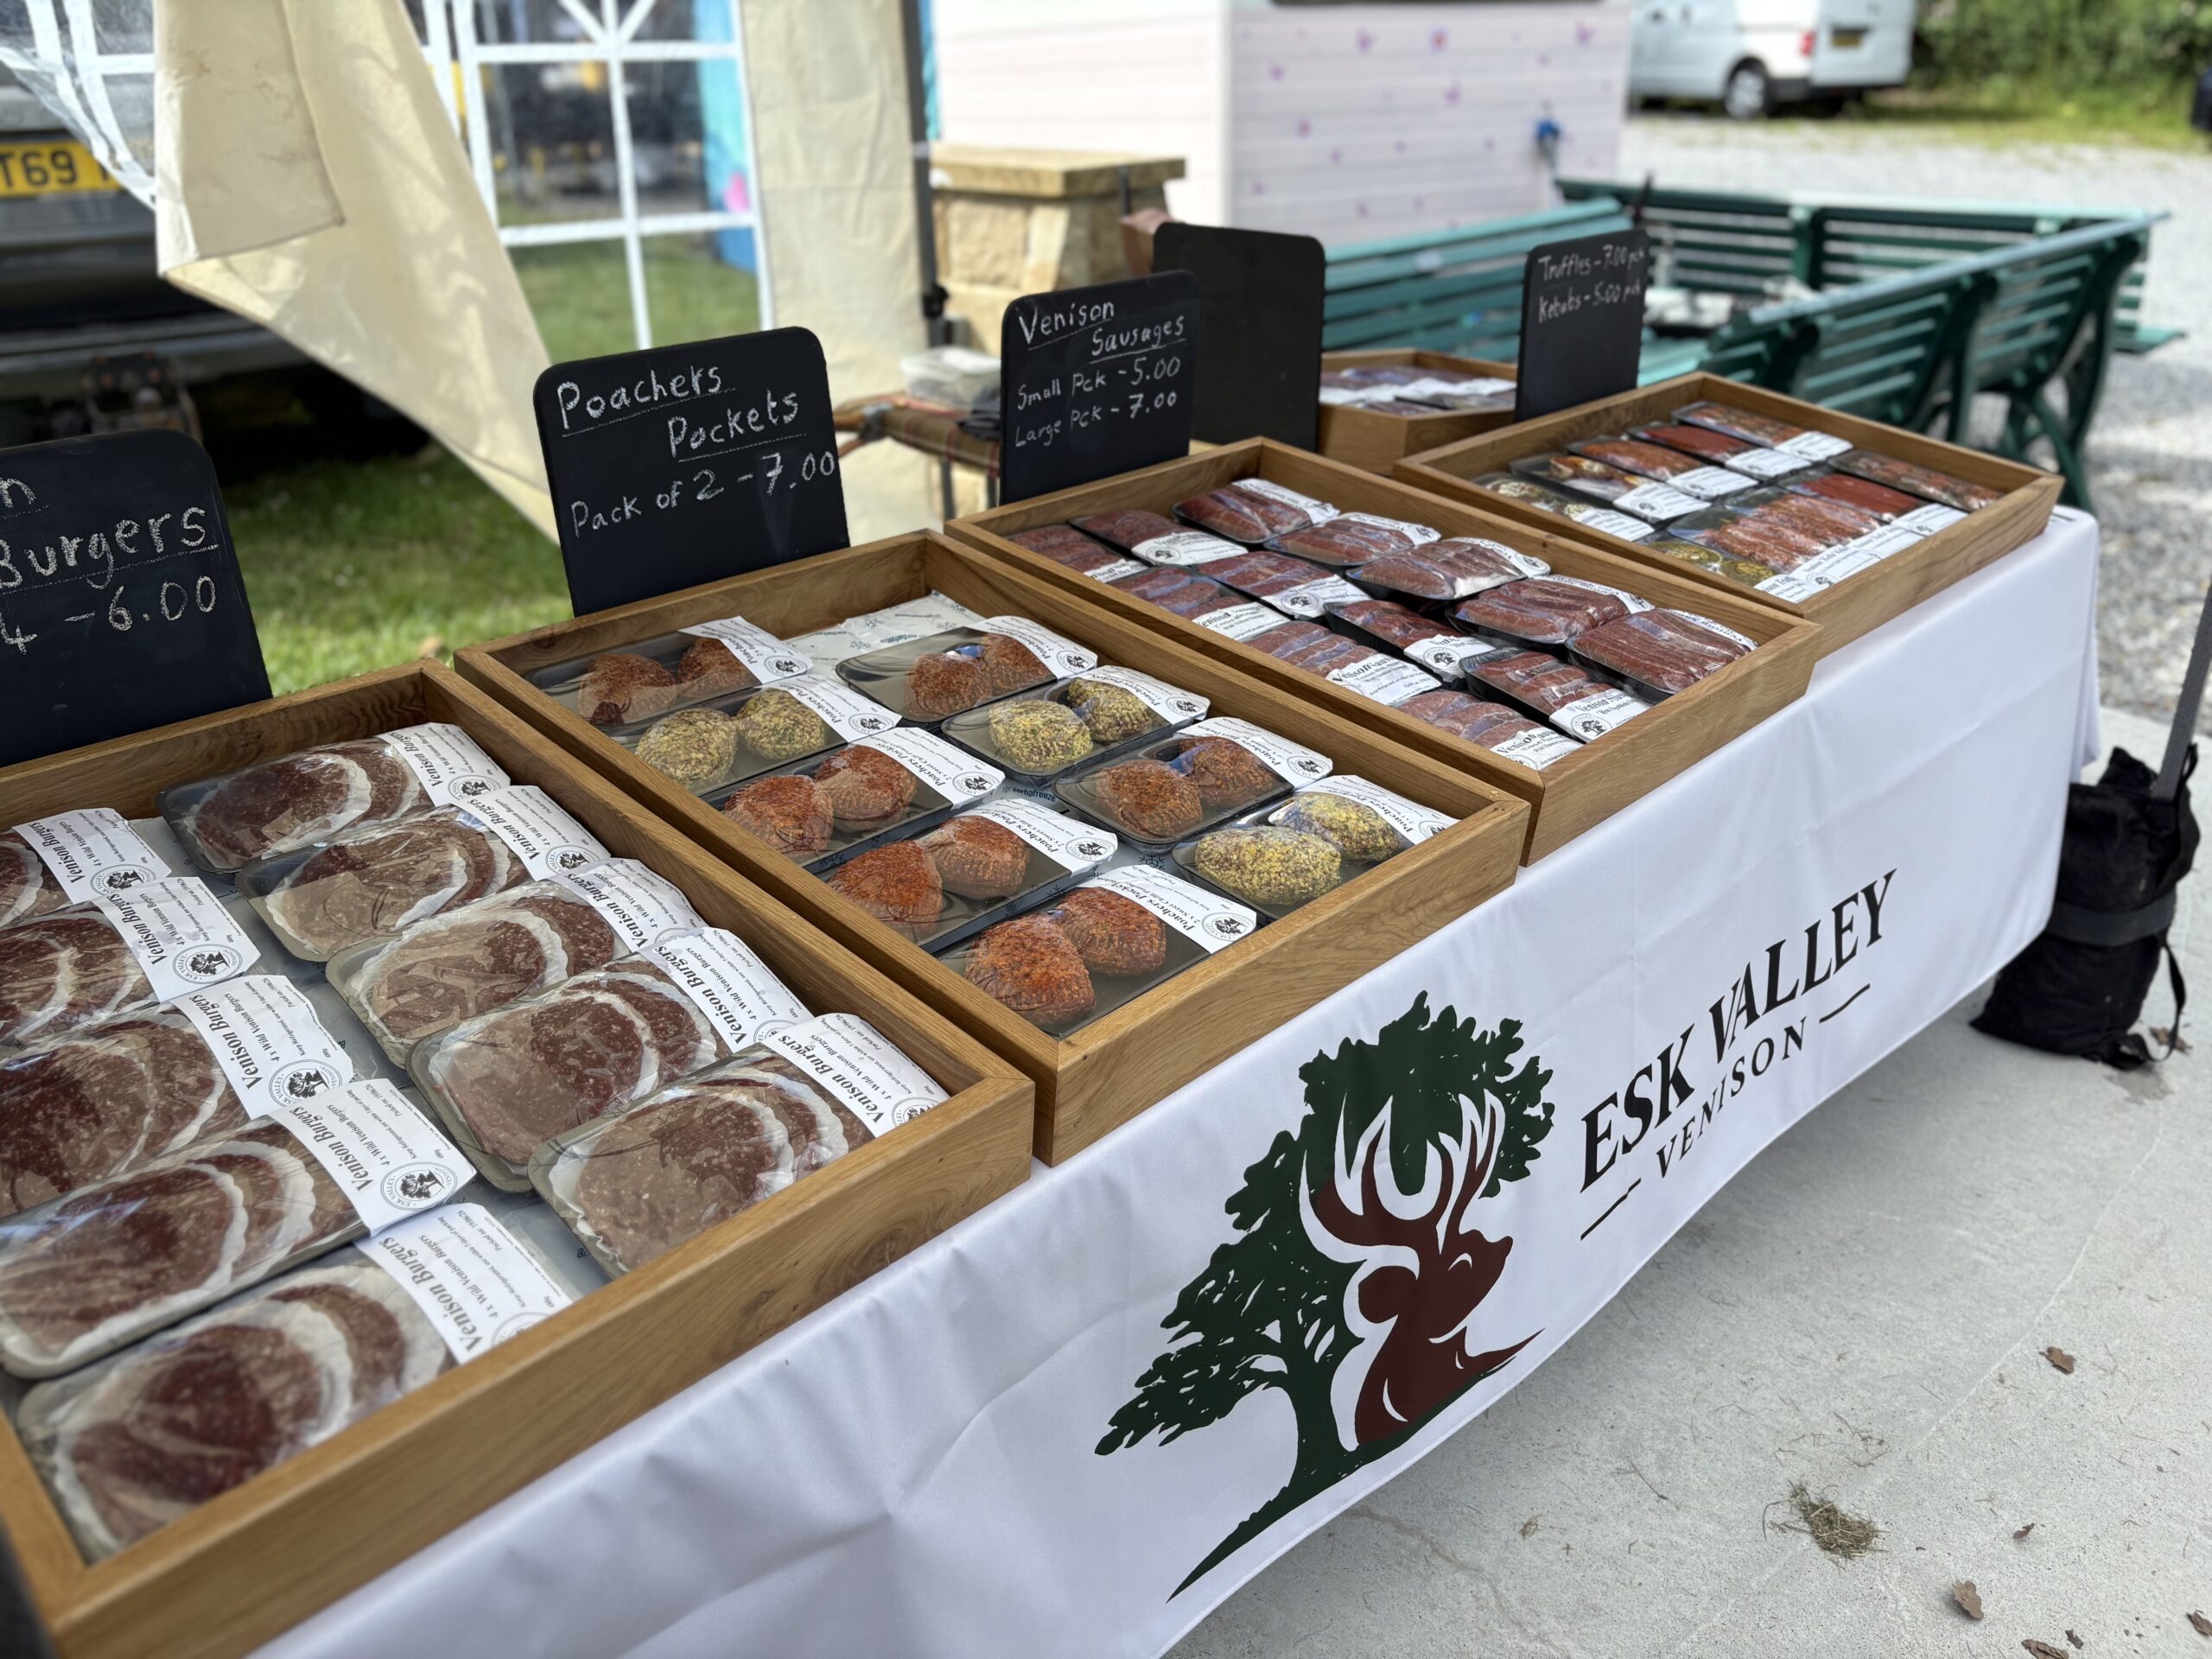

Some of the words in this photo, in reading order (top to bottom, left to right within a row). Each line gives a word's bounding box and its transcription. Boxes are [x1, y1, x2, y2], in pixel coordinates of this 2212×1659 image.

[1538, 254, 1591, 282] Truffles
[1019, 302, 1115, 344] Venison
[1091, 315, 1185, 355] Sausages
[557, 365, 721, 429] Poachers
[1018, 378, 1062, 410] Small
[668, 390, 798, 457] Pockets
[1015, 420, 1061, 447] Large
[571, 497, 642, 537] Pack
[657, 480, 683, 509] of
[694, 470, 724, 500] 2
[1198, 612, 1232, 627] enison
[728, 636, 759, 664] Poachers
[808, 696, 845, 724] Poachers
[1122, 682, 1161, 706] Poachers
[1574, 698, 1609, 712] Venison
[386, 729, 419, 752] Burgers
[1240, 740, 1281, 766] Poachers
[414, 753, 443, 786] Venison
[907, 758, 946, 786] Poachers
[467, 798, 506, 824] Burgers
[1012, 786, 1056, 803] sorbafreeze
[1369, 801, 1414, 833] Poachers
[23, 822, 60, 847] Burgers
[503, 824, 540, 860] Venison
[1017, 824, 1059, 853] Poachers
[52, 845, 86, 883] Venison
[564, 873, 609, 901] Burgers
[106, 893, 141, 923] Burgers
[606, 902, 649, 948] Venison
[1147, 899, 1195, 931] Poachers
[1168, 903, 1189, 917] Sweet
[132, 923, 168, 964] Venison
[654, 946, 705, 988] Burgers
[188, 995, 230, 1032] Burgers
[702, 988, 747, 1044] Venison
[1580, 1023, 1694, 1193] ESK
[1708, 868, 1897, 1064] VALLEY
[222, 1032, 263, 1090] Venison
[778, 1035, 834, 1075] Burgers
[831, 1073, 884, 1123] Venison
[1656, 1016, 1807, 1178] VENISON
[289, 1106, 335, 1142] Burgers
[327, 1141, 373, 1191] Venison
[378, 1236, 435, 1285] Burgers
[429, 1283, 482, 1351] Venison
